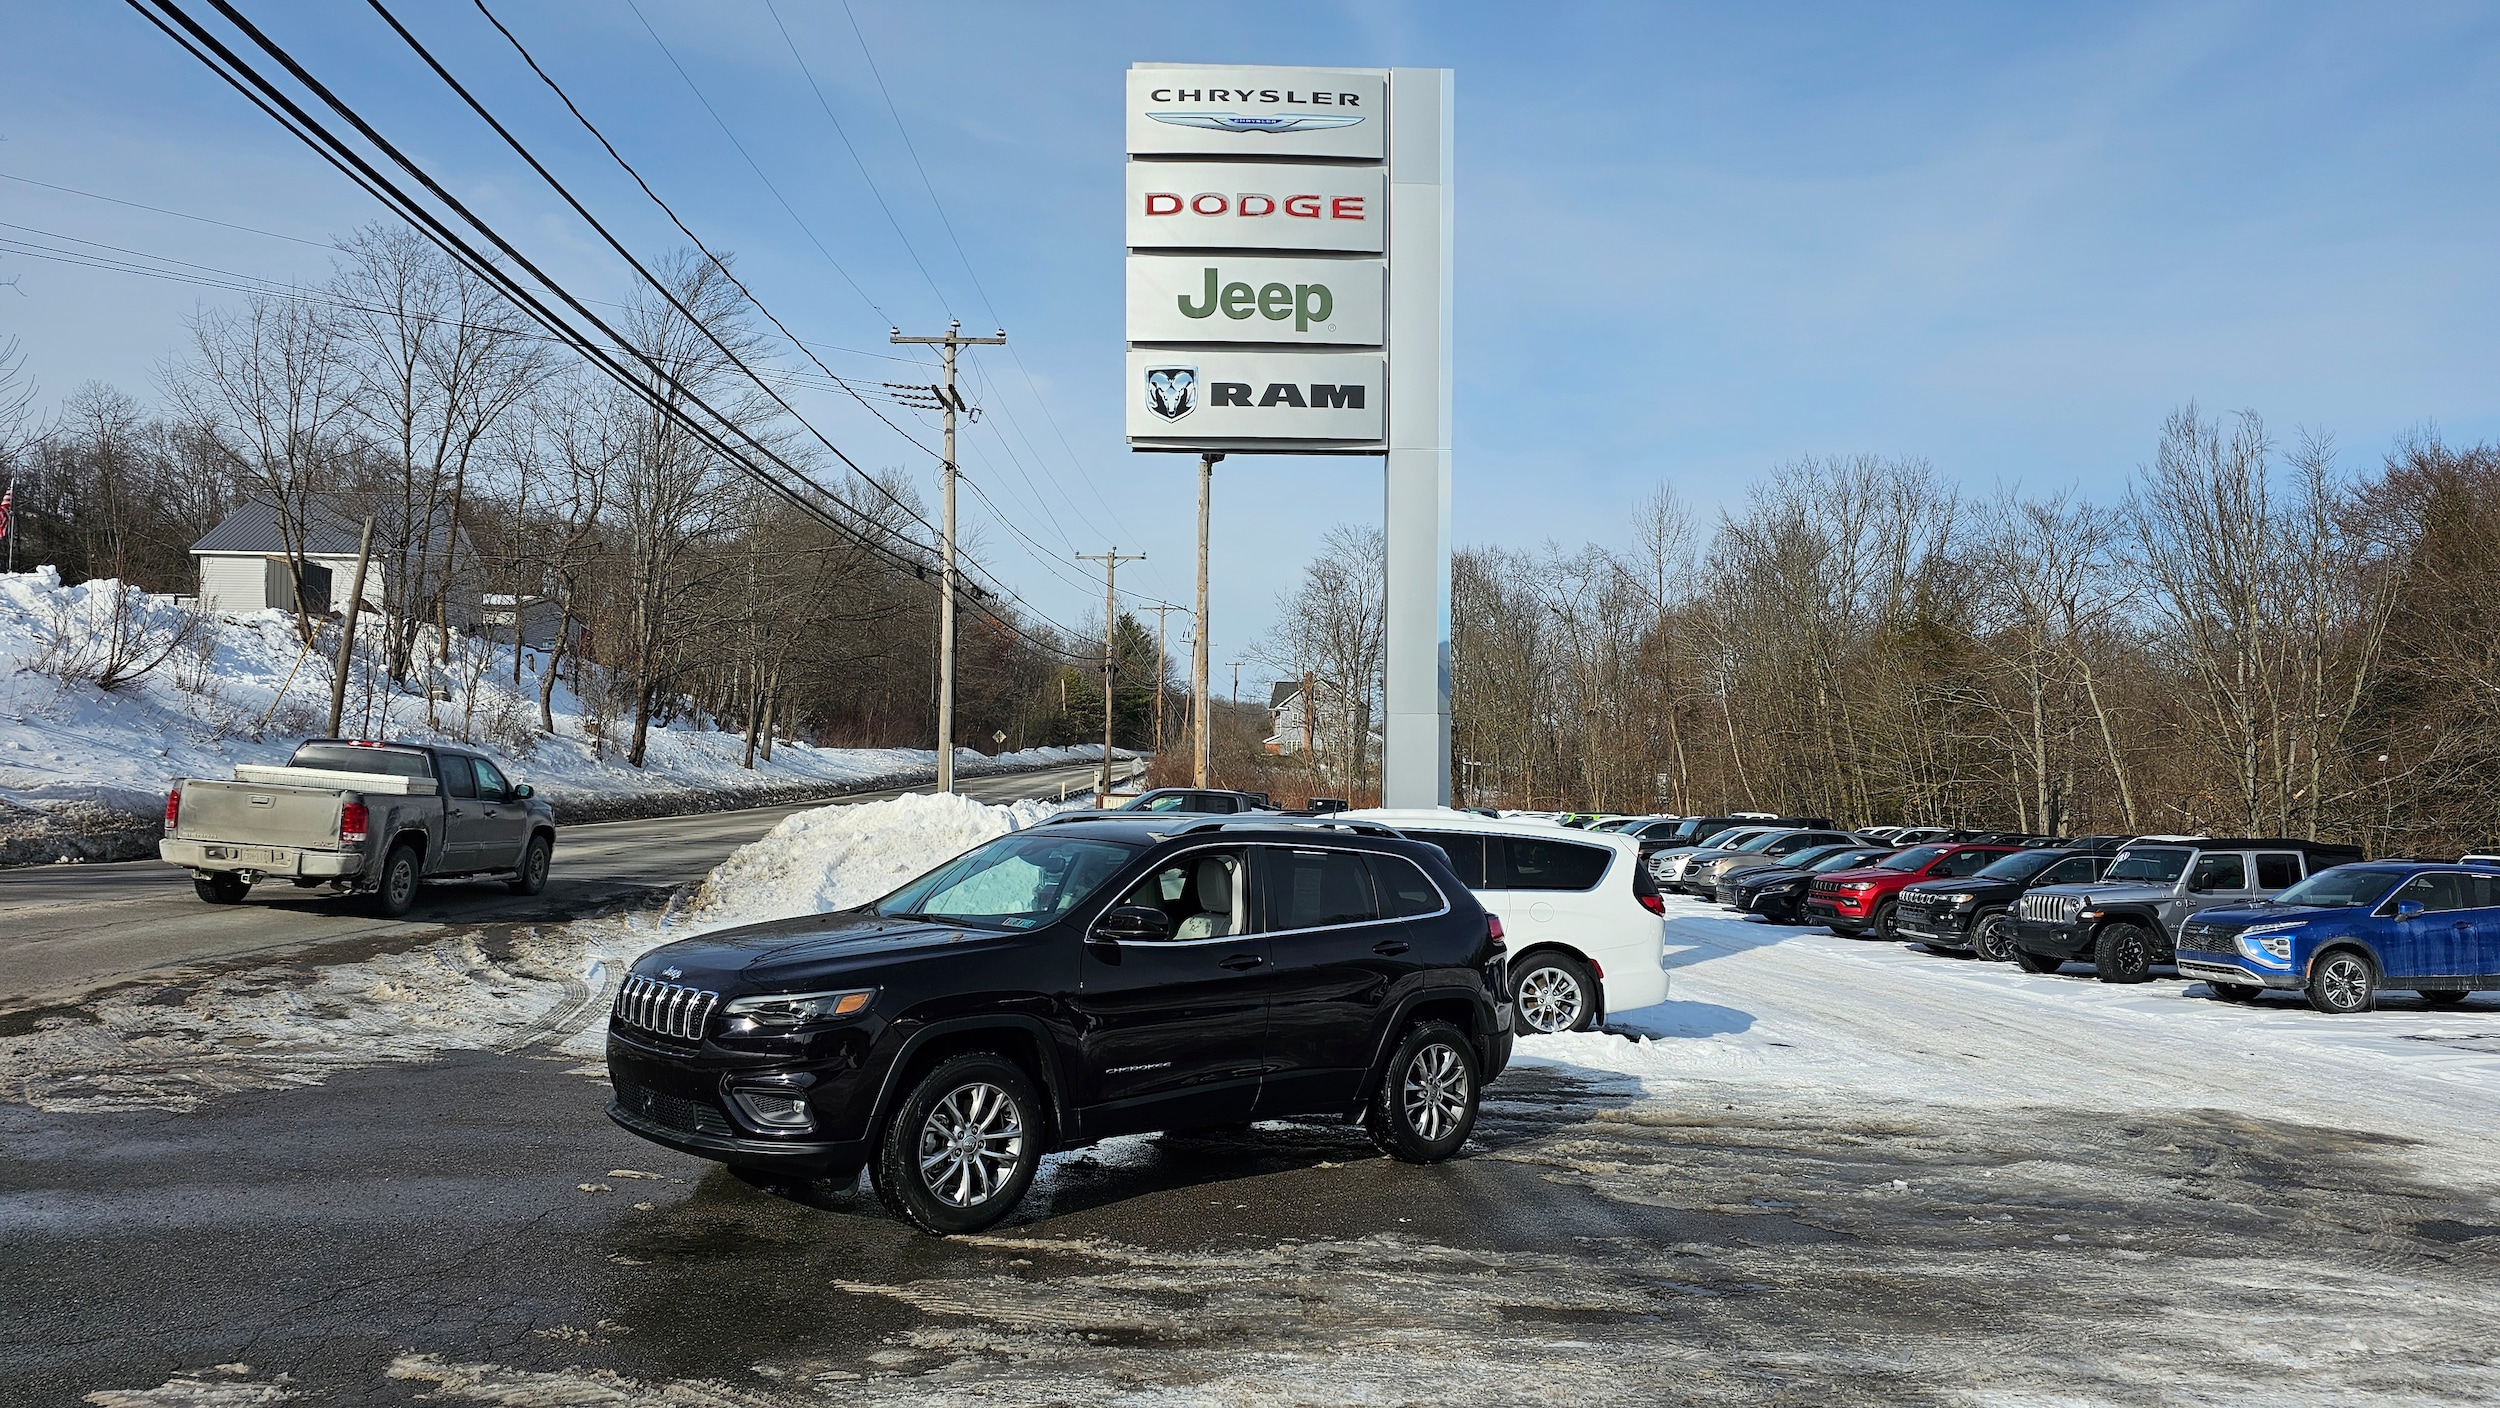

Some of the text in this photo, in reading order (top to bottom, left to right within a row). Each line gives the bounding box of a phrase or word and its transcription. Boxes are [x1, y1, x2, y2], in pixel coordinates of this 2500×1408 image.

[1151, 89, 1360, 106] CHRYSLER
[1145, 193, 1366, 221] DODGE
[1177, 267, 1333, 332] Jeep
[1210, 382, 1365, 409] RAM
[1105, 1061, 1171, 1074] CHEROKEE
